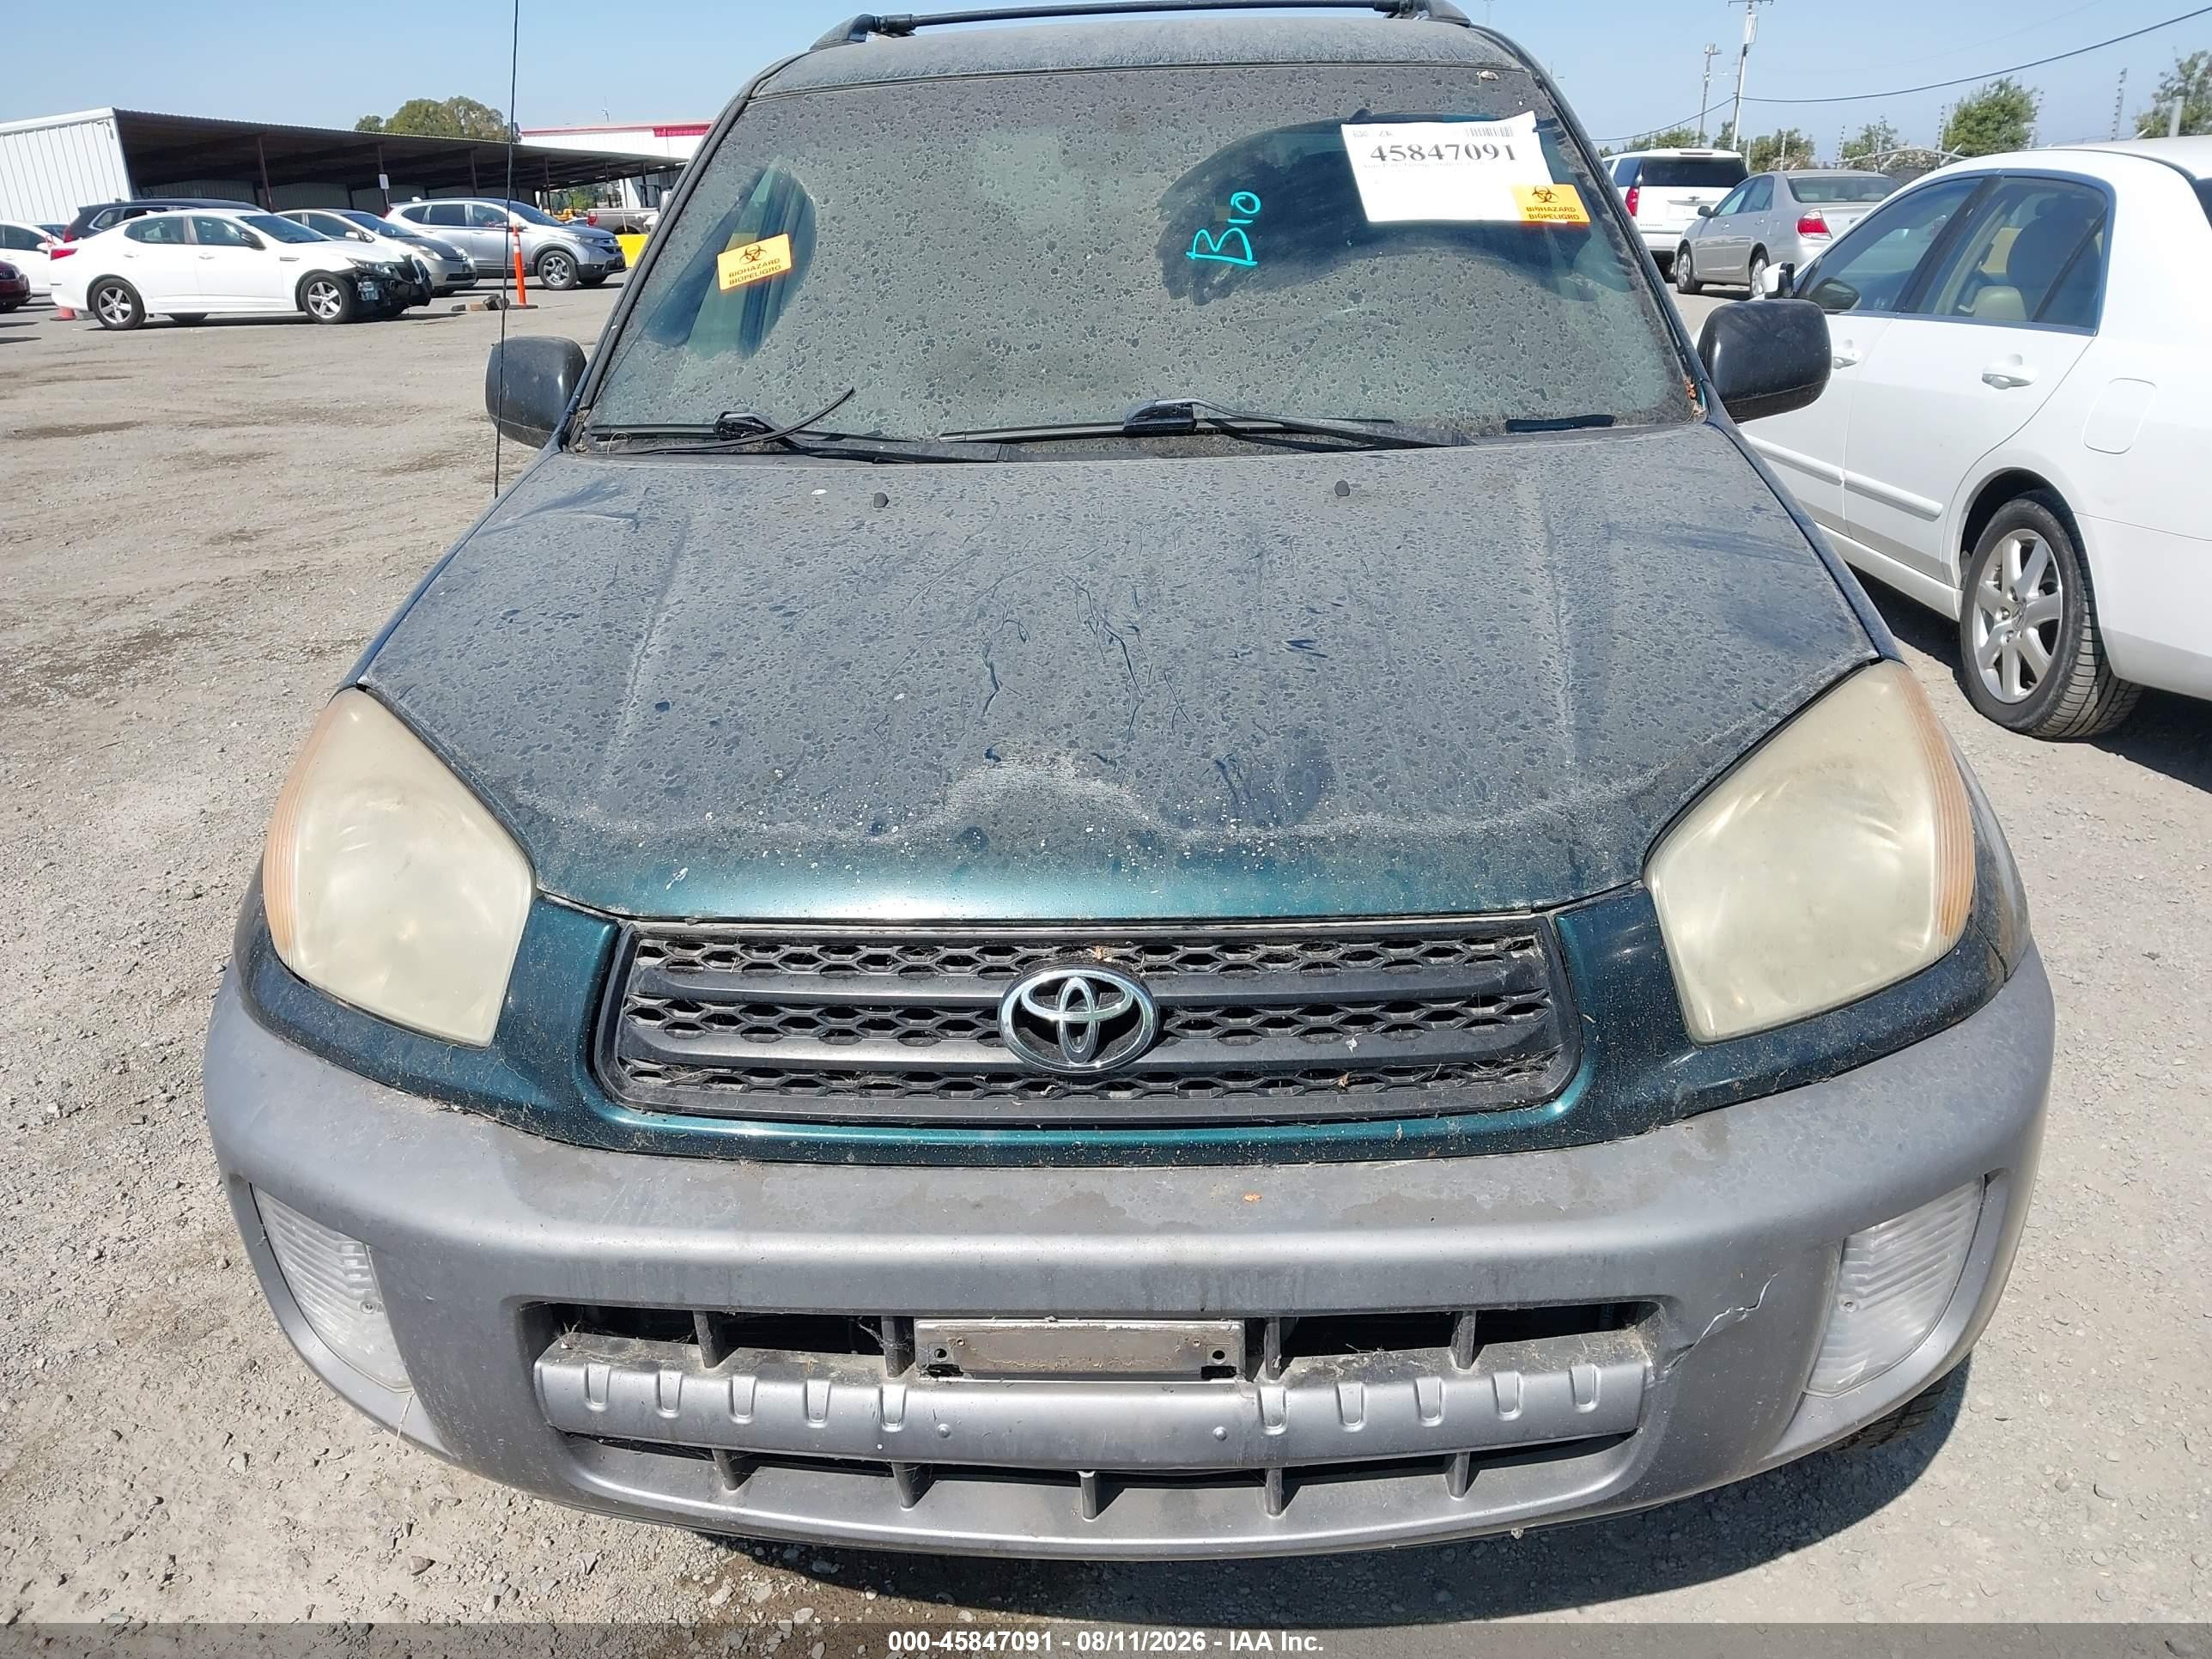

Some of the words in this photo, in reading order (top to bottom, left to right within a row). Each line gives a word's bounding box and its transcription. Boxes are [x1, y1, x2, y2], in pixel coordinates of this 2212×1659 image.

[1370, 143, 1516, 161] 45847091
[729, 258, 781, 277] BIOHAZARD
[729, 265, 781, 285] BIOPELIGRO
